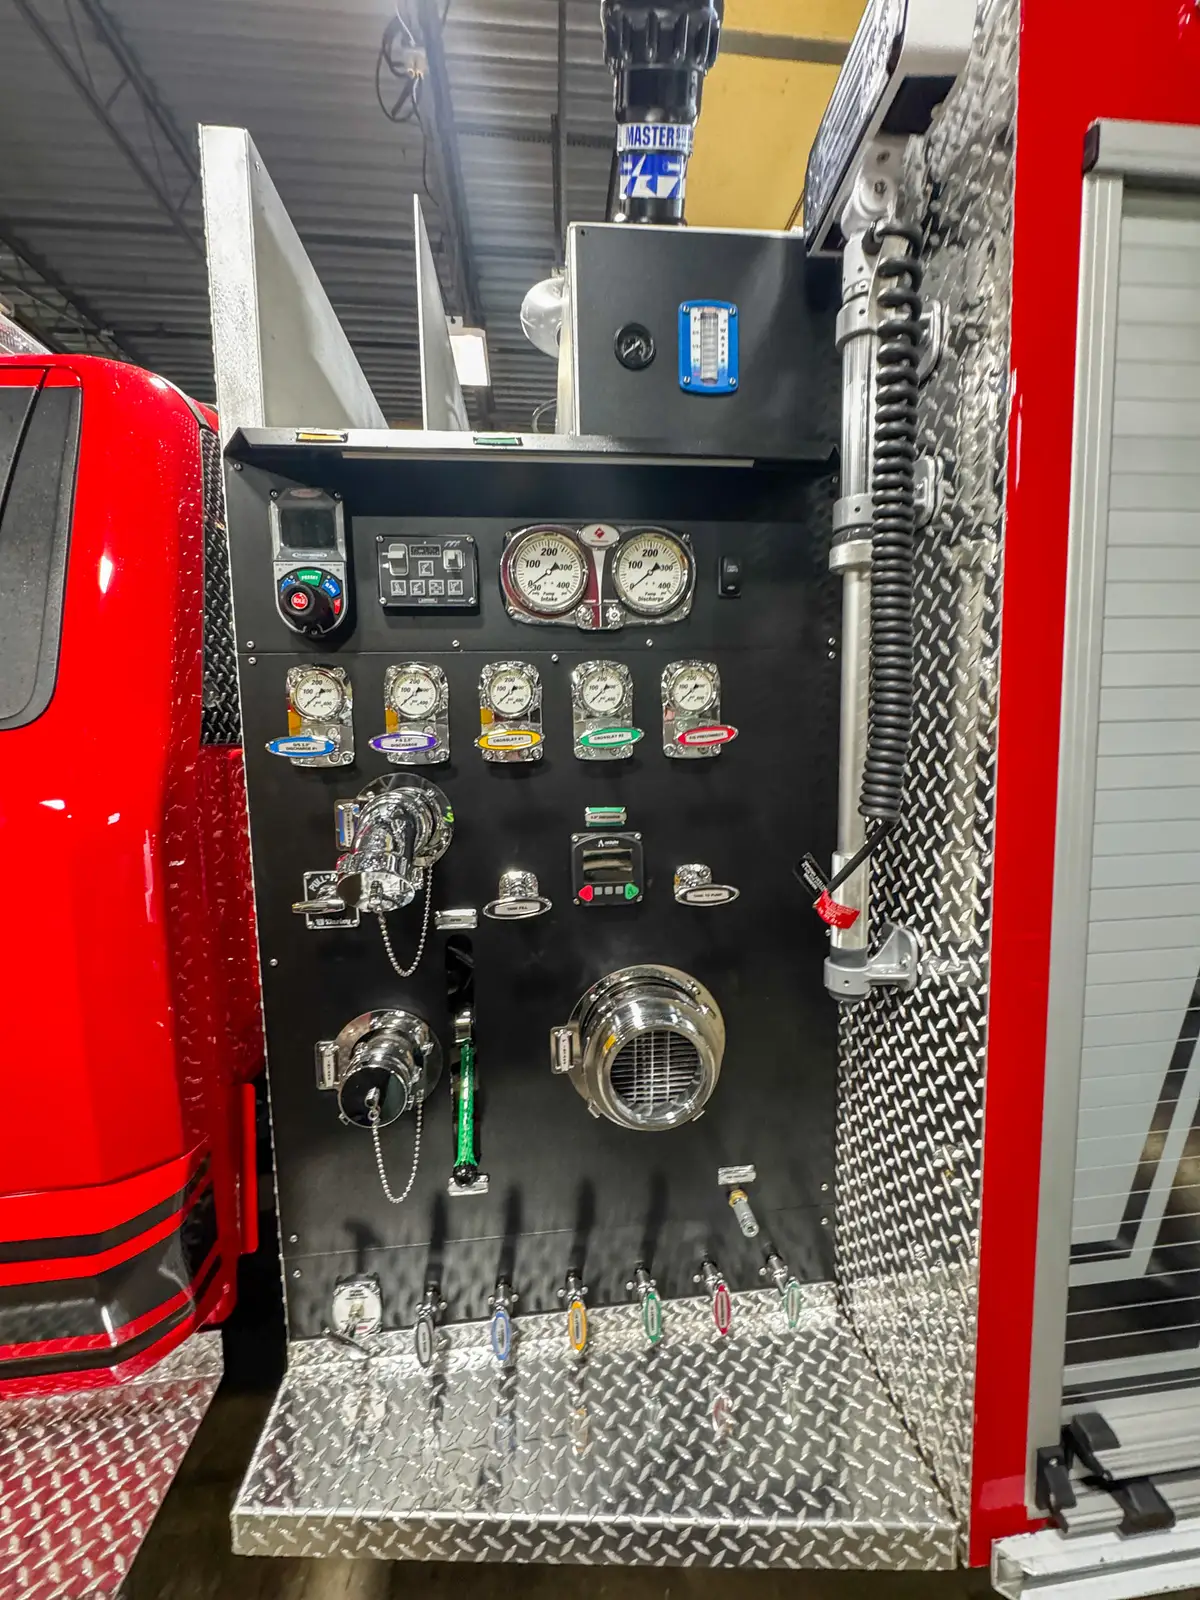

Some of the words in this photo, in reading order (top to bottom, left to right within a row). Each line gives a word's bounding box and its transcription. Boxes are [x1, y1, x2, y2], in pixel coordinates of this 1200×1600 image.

[627, 126, 674, 146] MASTER
[540, 547, 558, 556] 200
[642, 549, 658, 558] 200
[525, 560, 541, 568] 100
[628, 561, 642, 569] 100
[325, 582, 336, 593] RPM
[308, 875, 326, 892] PULL
